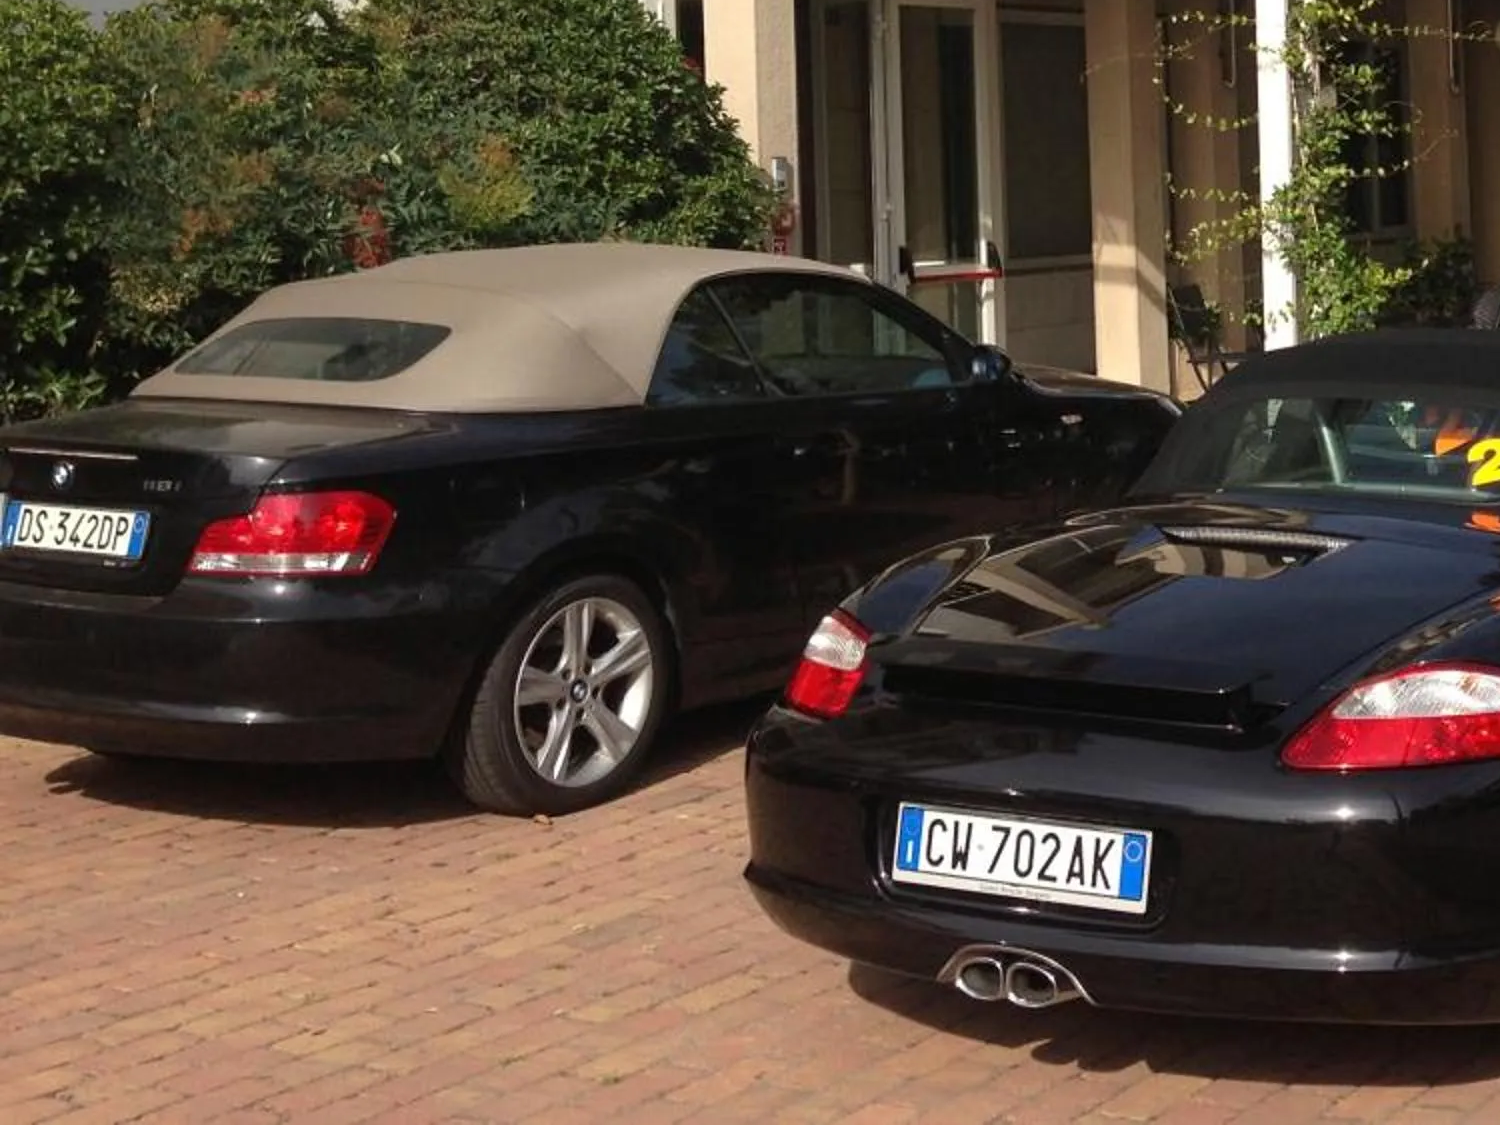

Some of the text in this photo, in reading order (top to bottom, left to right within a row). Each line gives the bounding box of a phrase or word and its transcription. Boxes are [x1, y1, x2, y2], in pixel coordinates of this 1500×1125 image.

[18, 508, 130, 551] DS 342DP
[925, 818, 1116, 890] CW 702AK
